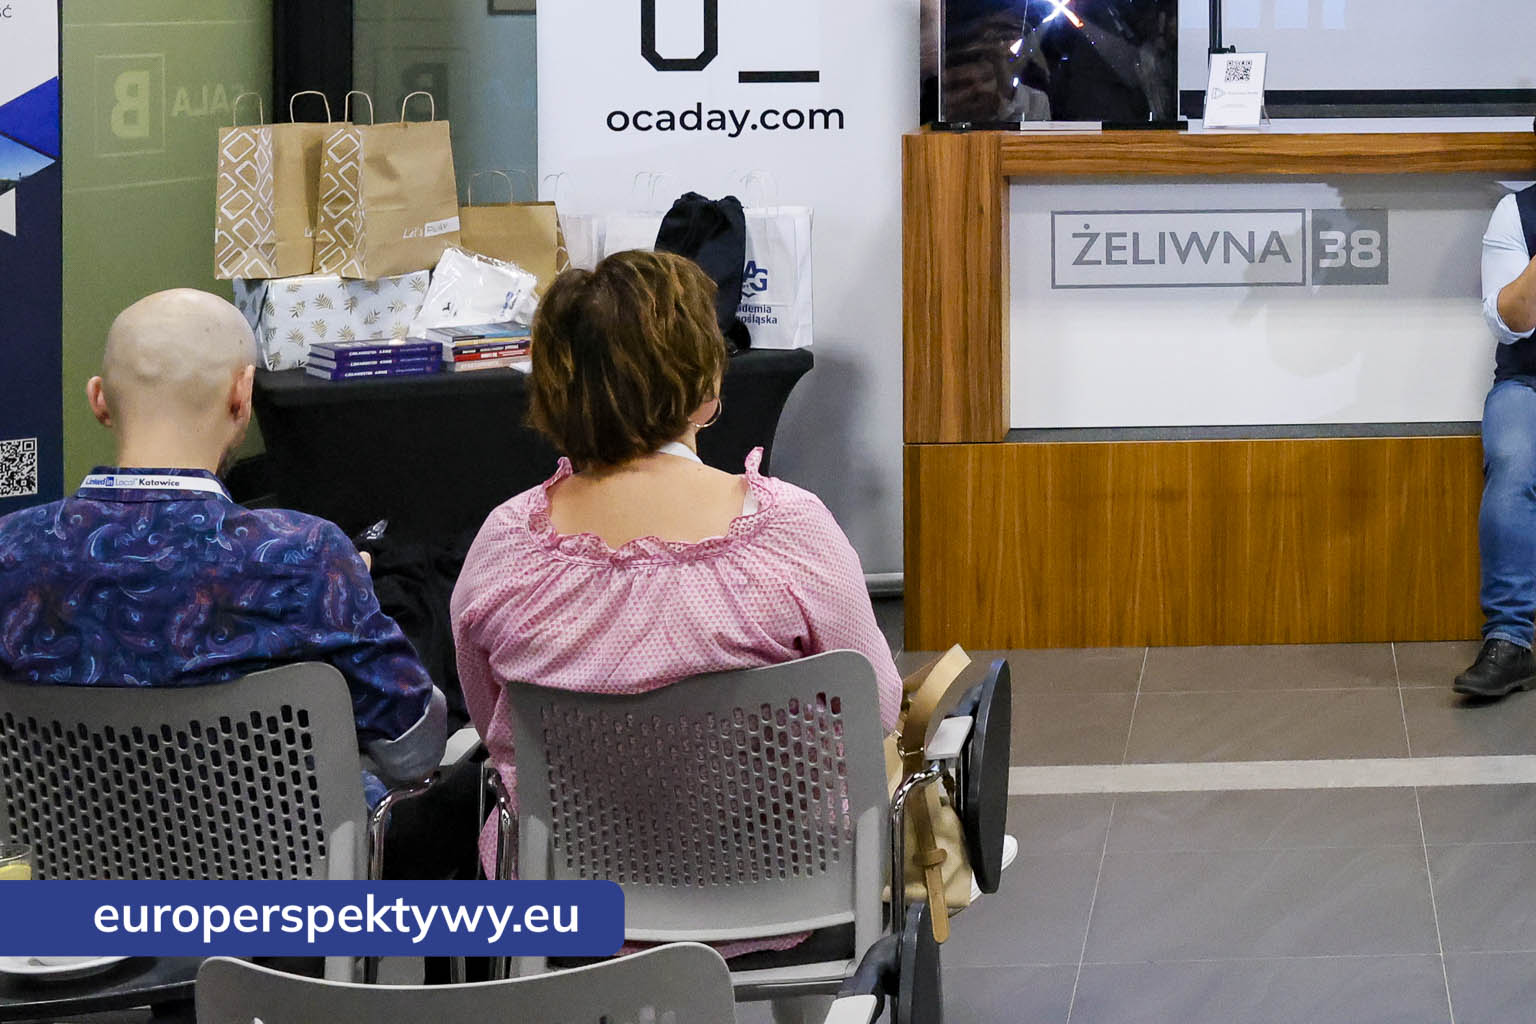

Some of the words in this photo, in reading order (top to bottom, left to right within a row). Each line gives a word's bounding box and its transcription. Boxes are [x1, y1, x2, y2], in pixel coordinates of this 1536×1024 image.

[606, 101, 845, 138] ocaday.com
[1071, 222, 1292, 267] ŻELIWNA
[1318, 229, 1382, 269] 38
[139, 477, 180, 487] Katowice
